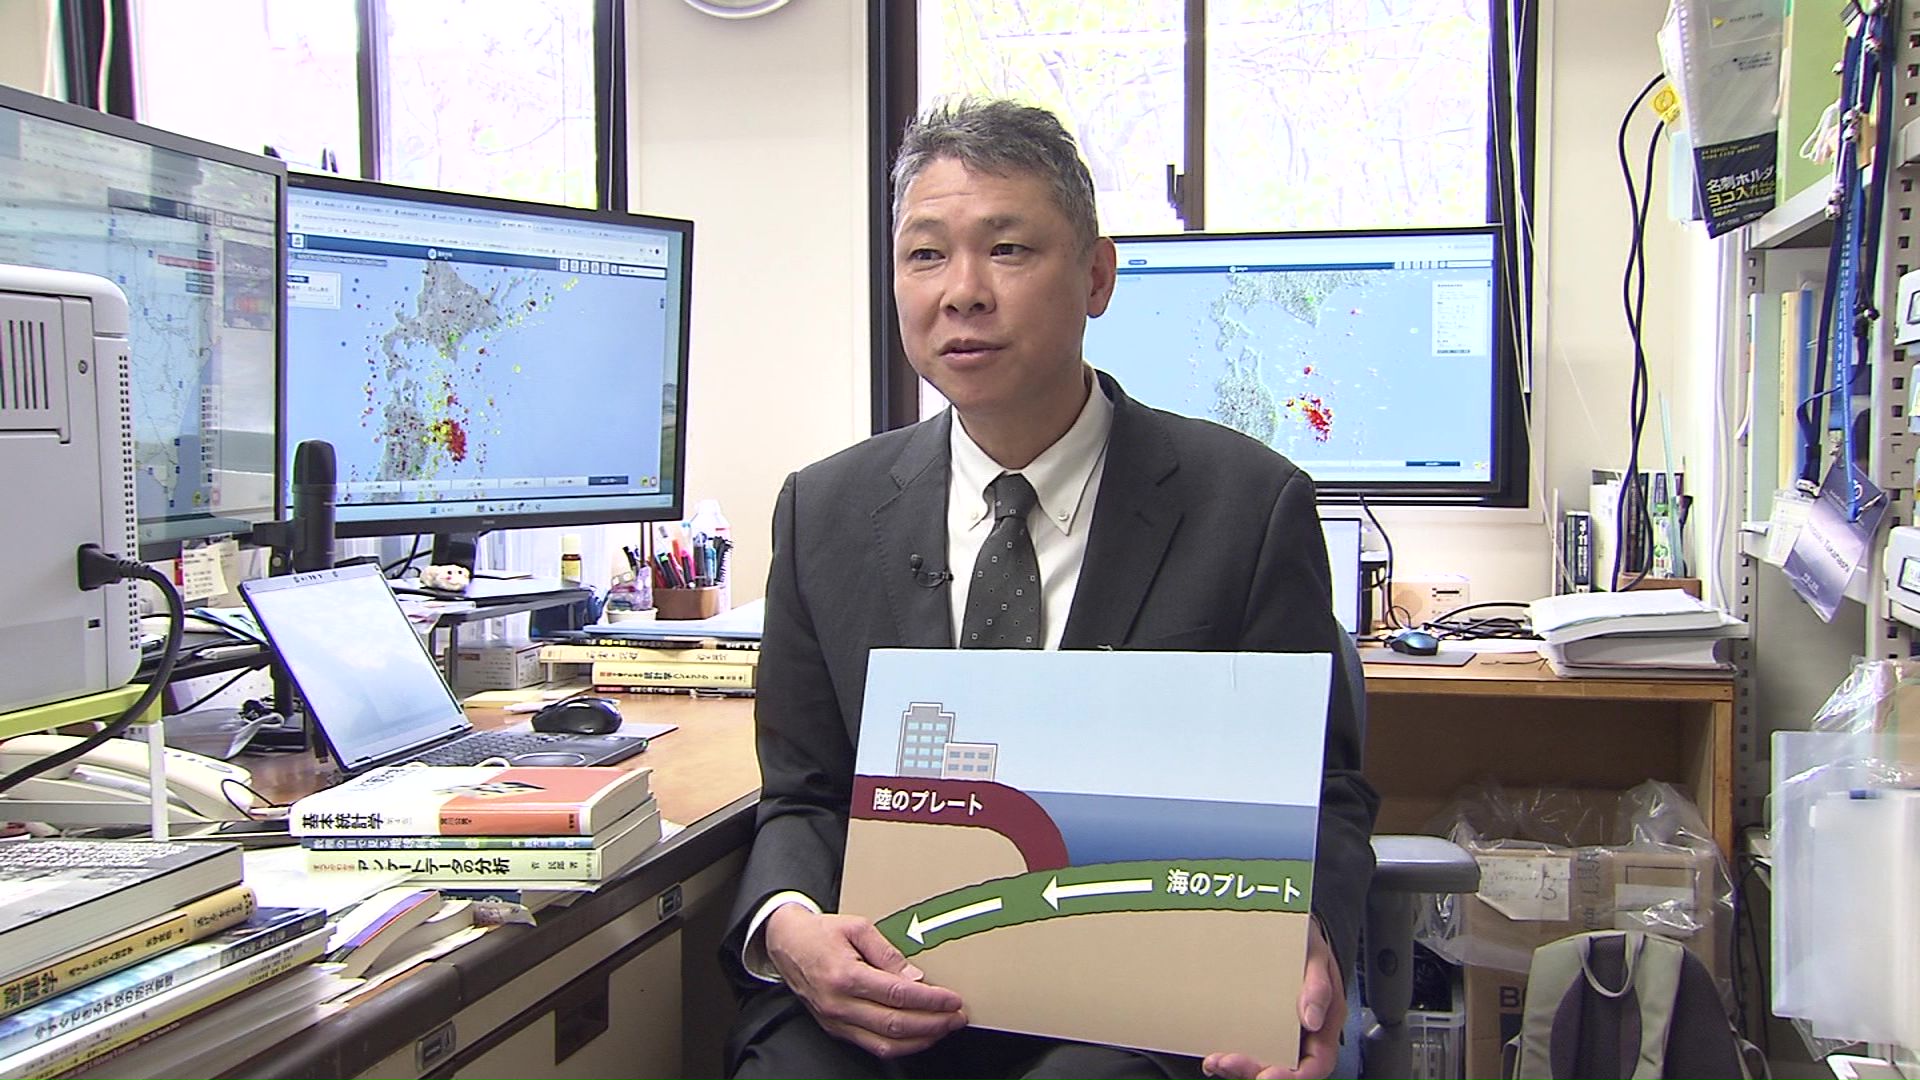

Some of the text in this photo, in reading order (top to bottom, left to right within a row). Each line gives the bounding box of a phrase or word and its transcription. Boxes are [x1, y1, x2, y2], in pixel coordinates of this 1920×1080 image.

[872, 787, 984, 816] 陸のプレート
[302, 813, 384, 829] 基本統計学
[358, 857, 510, 875] アンケートデータの分析
[1166, 869, 1302, 904] 海のプレート
[1500, 985, 1526, 1008] B
